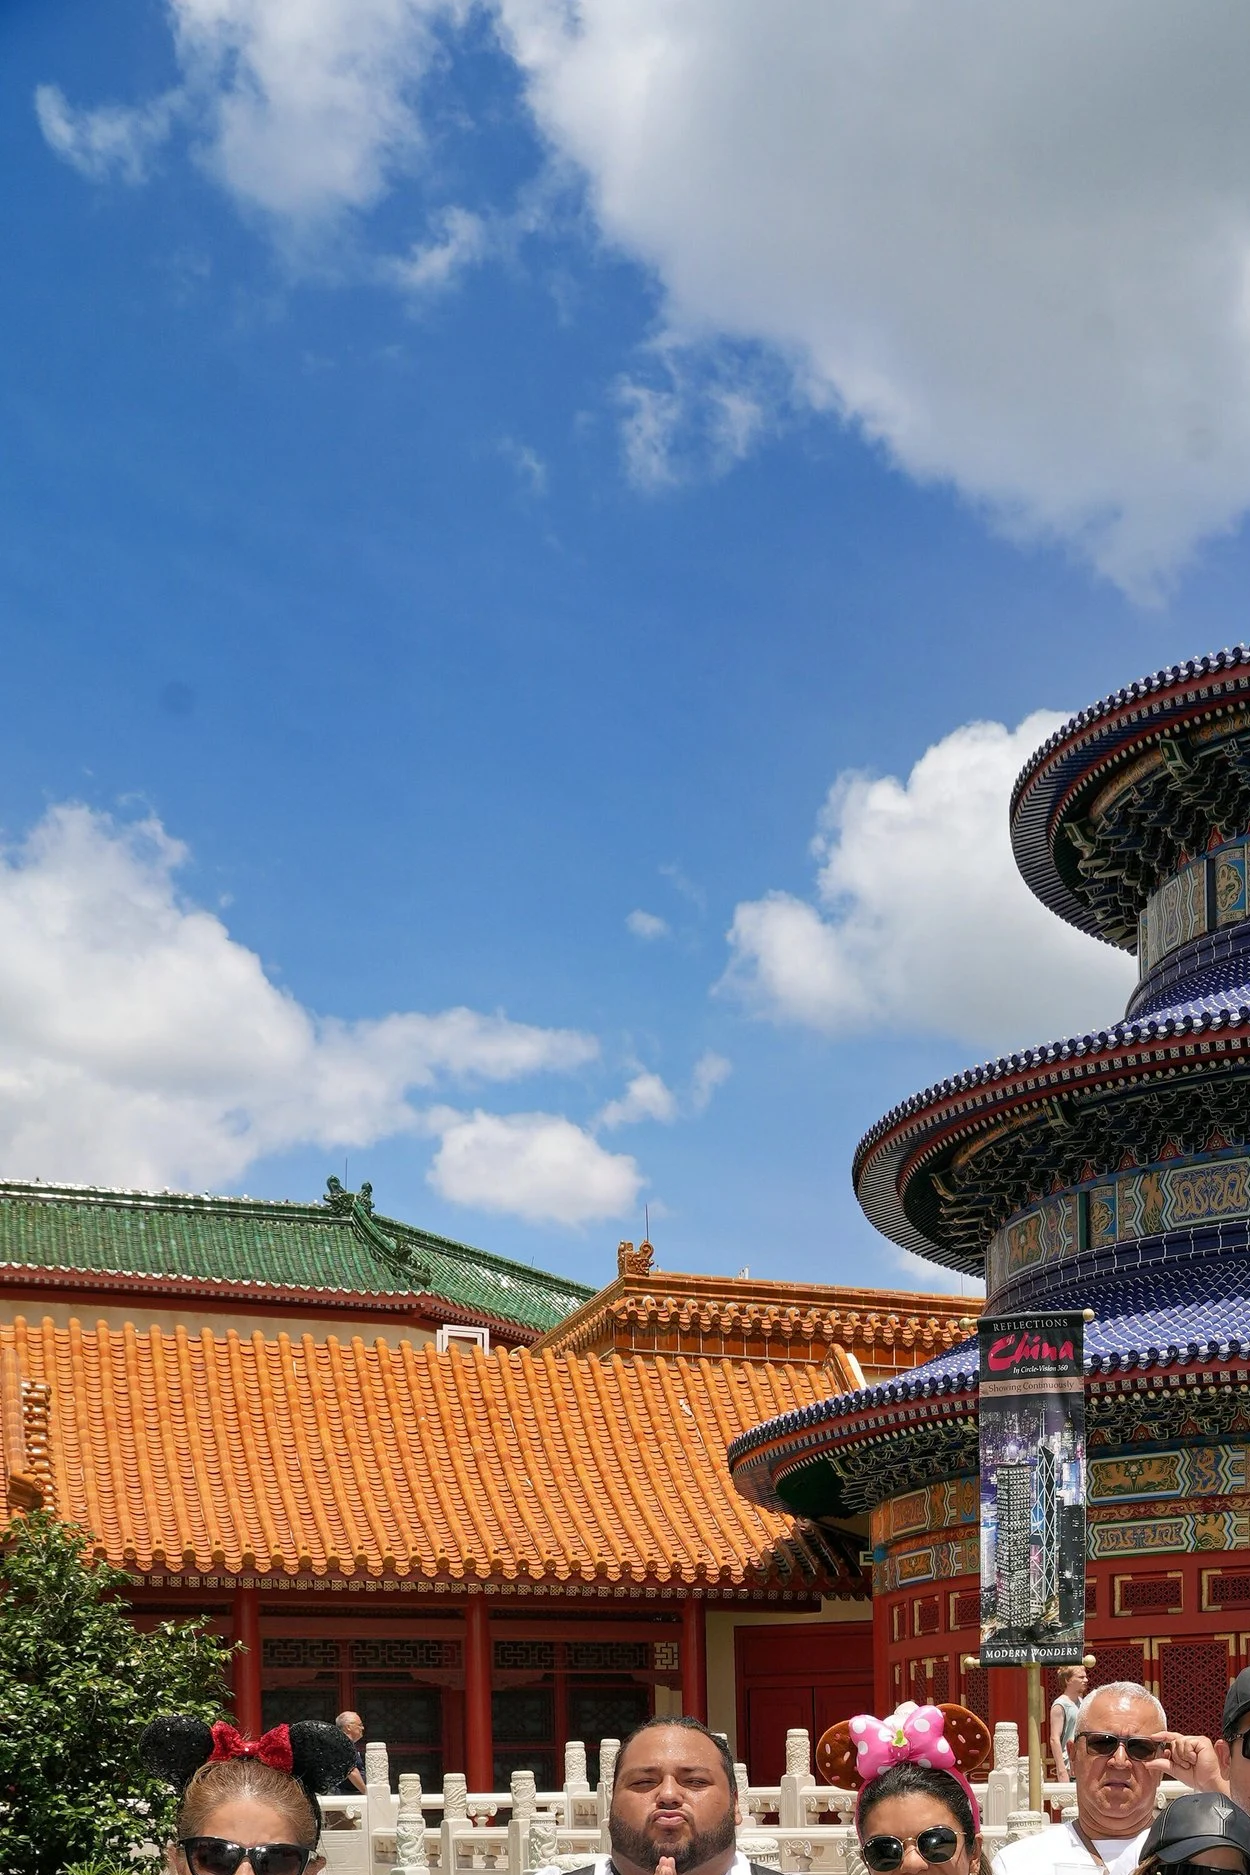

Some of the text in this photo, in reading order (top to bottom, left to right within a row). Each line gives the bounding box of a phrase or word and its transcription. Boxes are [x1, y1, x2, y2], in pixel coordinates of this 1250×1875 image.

[993, 1319, 1068, 1332] REFLECTIONS
[988, 1332, 1074, 1371] China
[1020, 1364, 1057, 1373] Circle-Vision
[988, 1381, 1075, 1393] Showing Continuously
[985, 1647, 1078, 1659] MODERN WONDERS
